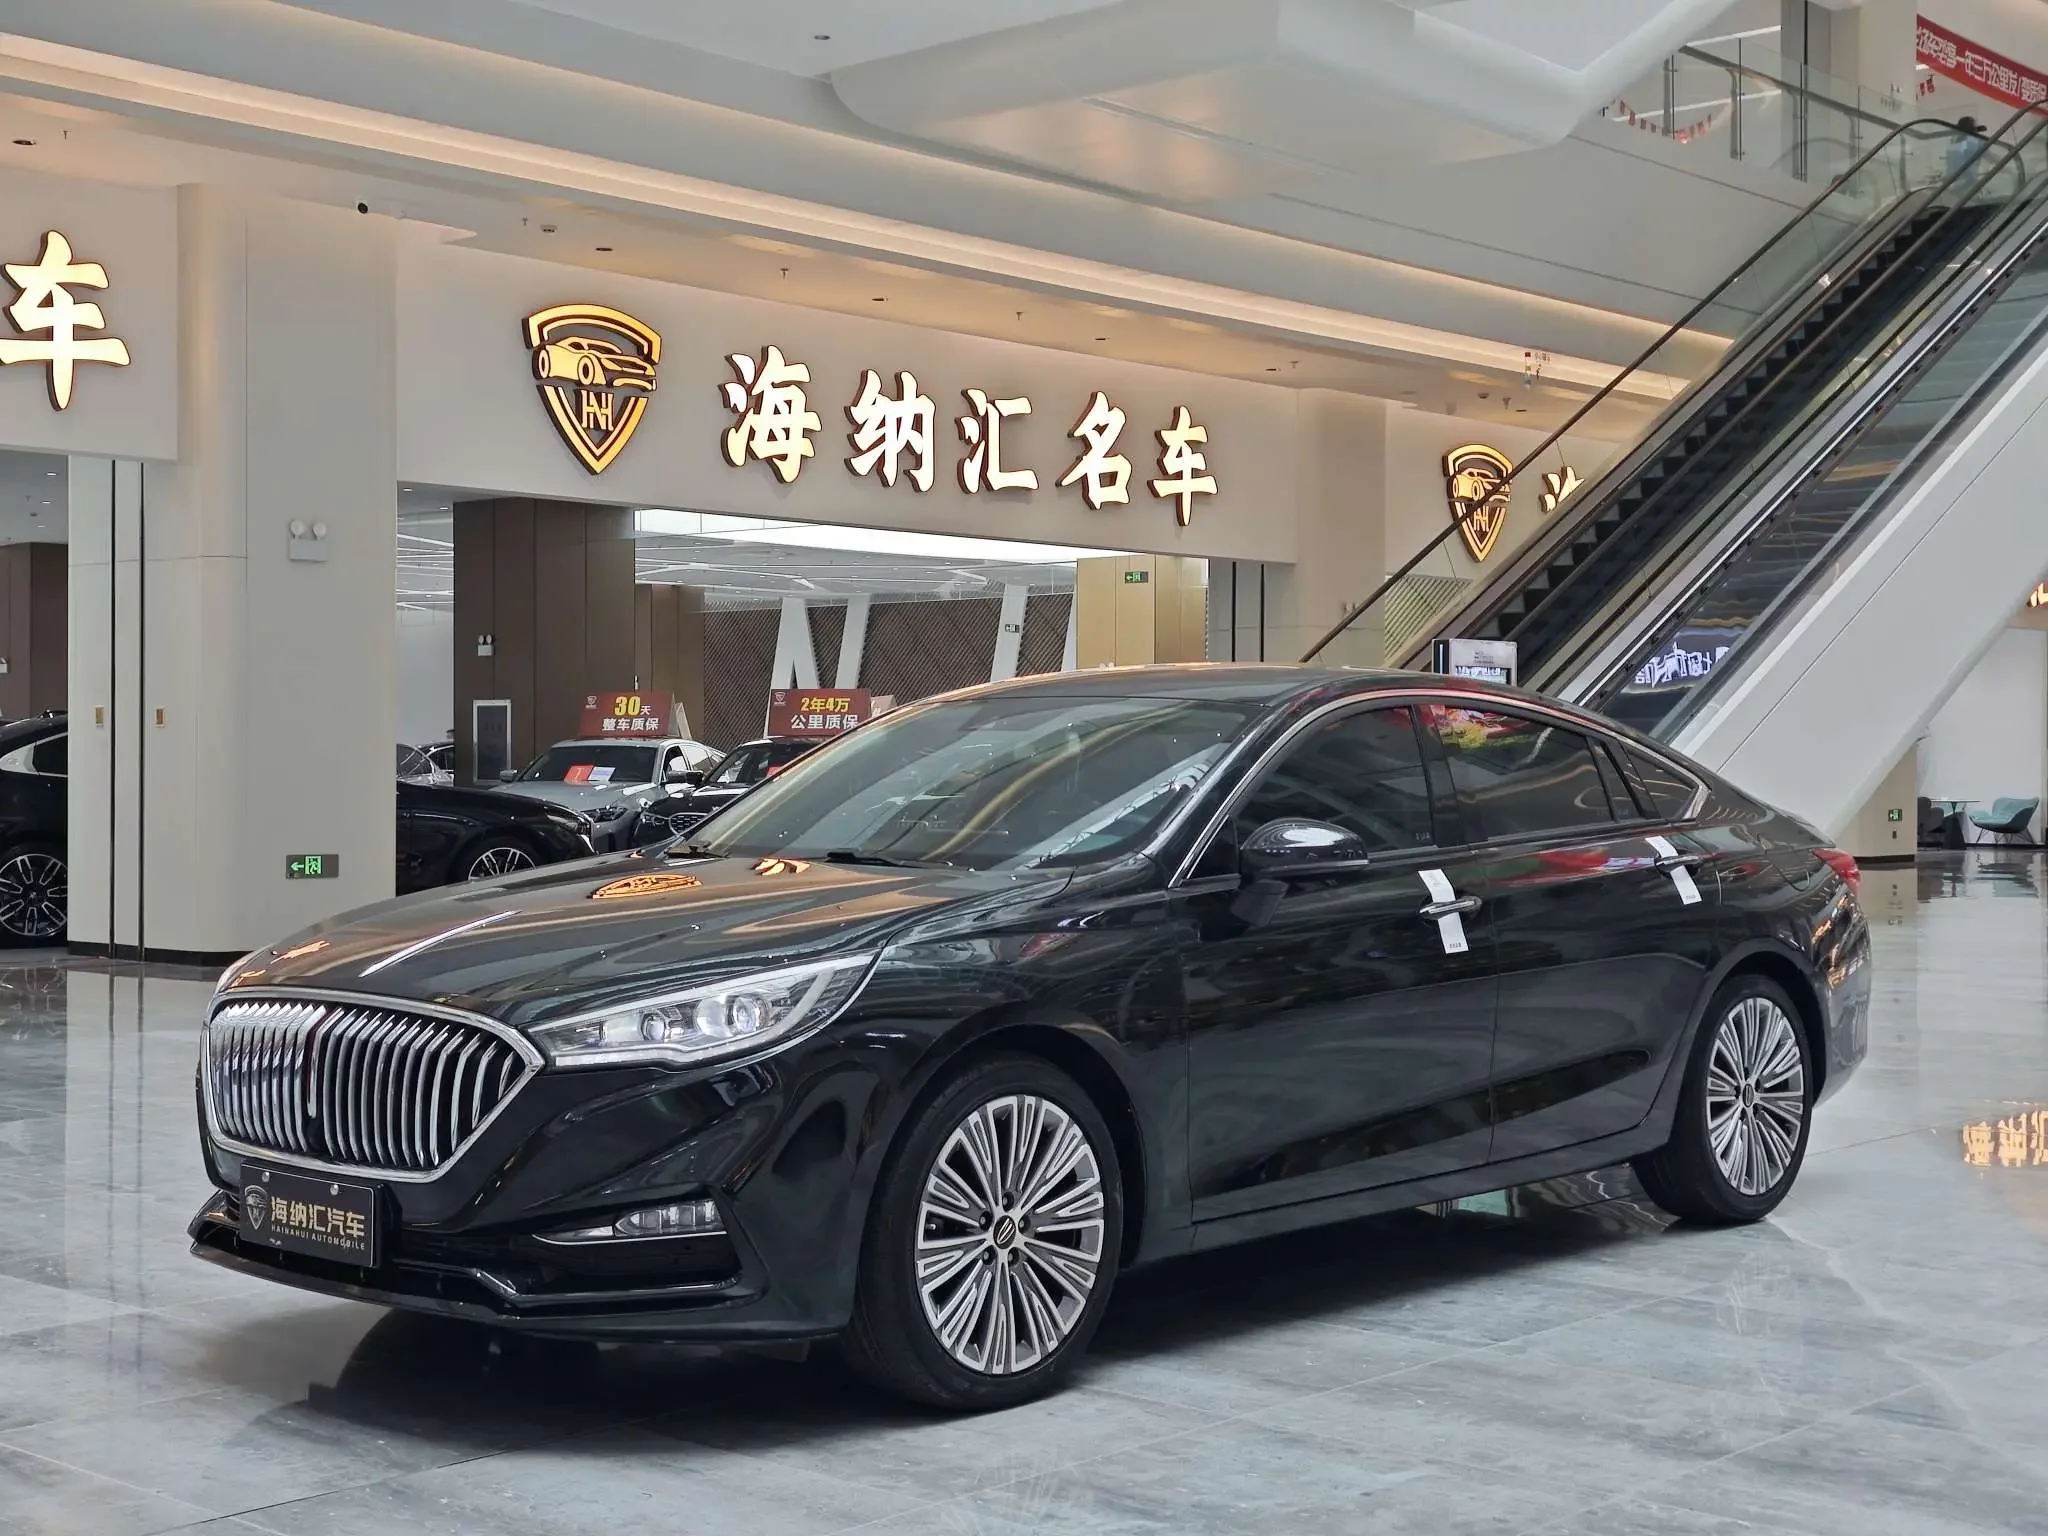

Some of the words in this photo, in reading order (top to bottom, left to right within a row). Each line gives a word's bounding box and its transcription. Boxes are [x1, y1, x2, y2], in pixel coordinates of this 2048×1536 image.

[0, 229, 131, 411] 车
[718, 344, 1219, 527] 海纳汇名车
[614, 695, 652, 716] 30天
[800, 697, 851, 713] 2年4万
[602, 717, 659, 731] 整车质保
[790, 714, 858, 729] 公里质保
[271, 1196, 365, 1238] 海纳汇汽车
[271, 1224, 309, 1240] HAINAHUI
[311, 1232, 365, 1251] AUTOMOBILE
